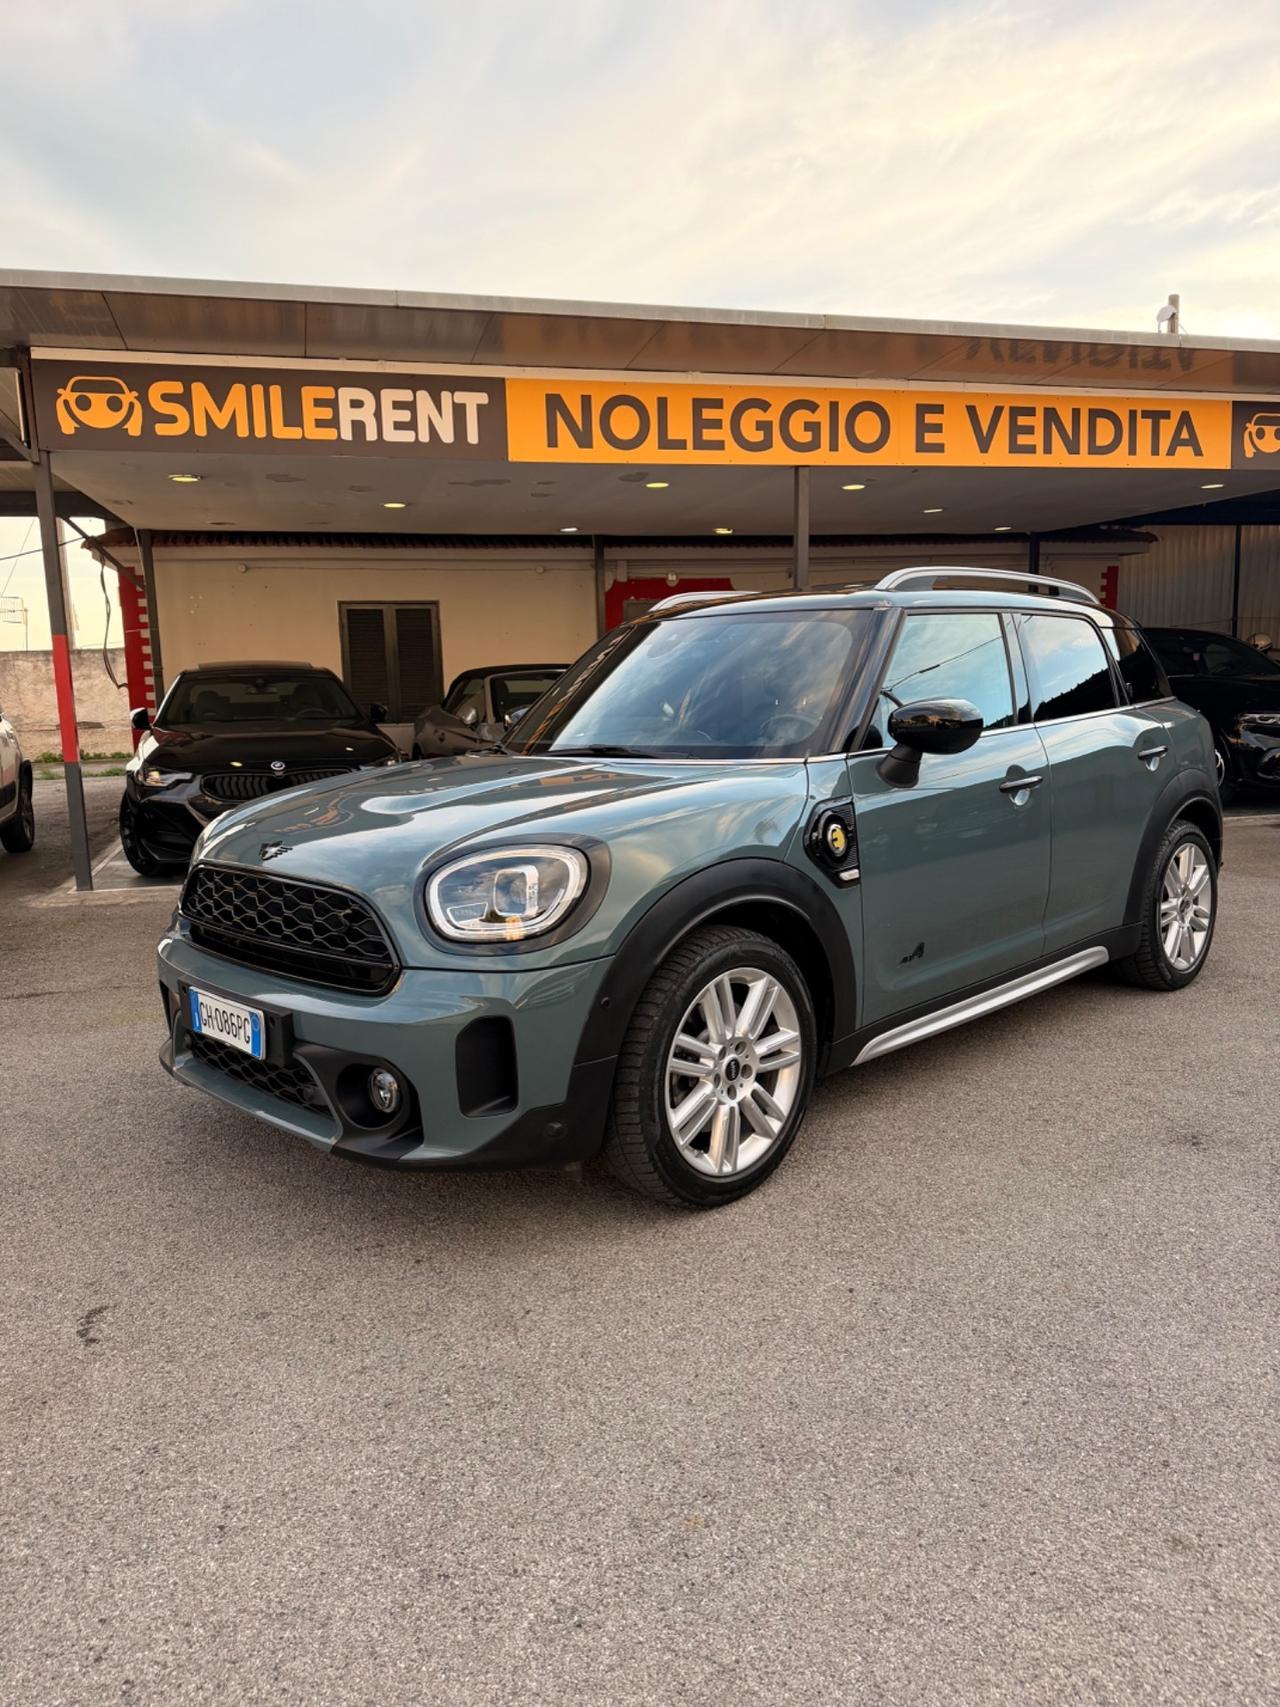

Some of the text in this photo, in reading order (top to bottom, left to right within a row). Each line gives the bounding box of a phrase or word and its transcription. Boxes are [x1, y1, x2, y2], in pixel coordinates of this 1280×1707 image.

[148, 381, 489, 444] SMILERENT
[545, 393, 1203, 456] NOLEGGIO E VENDITA
